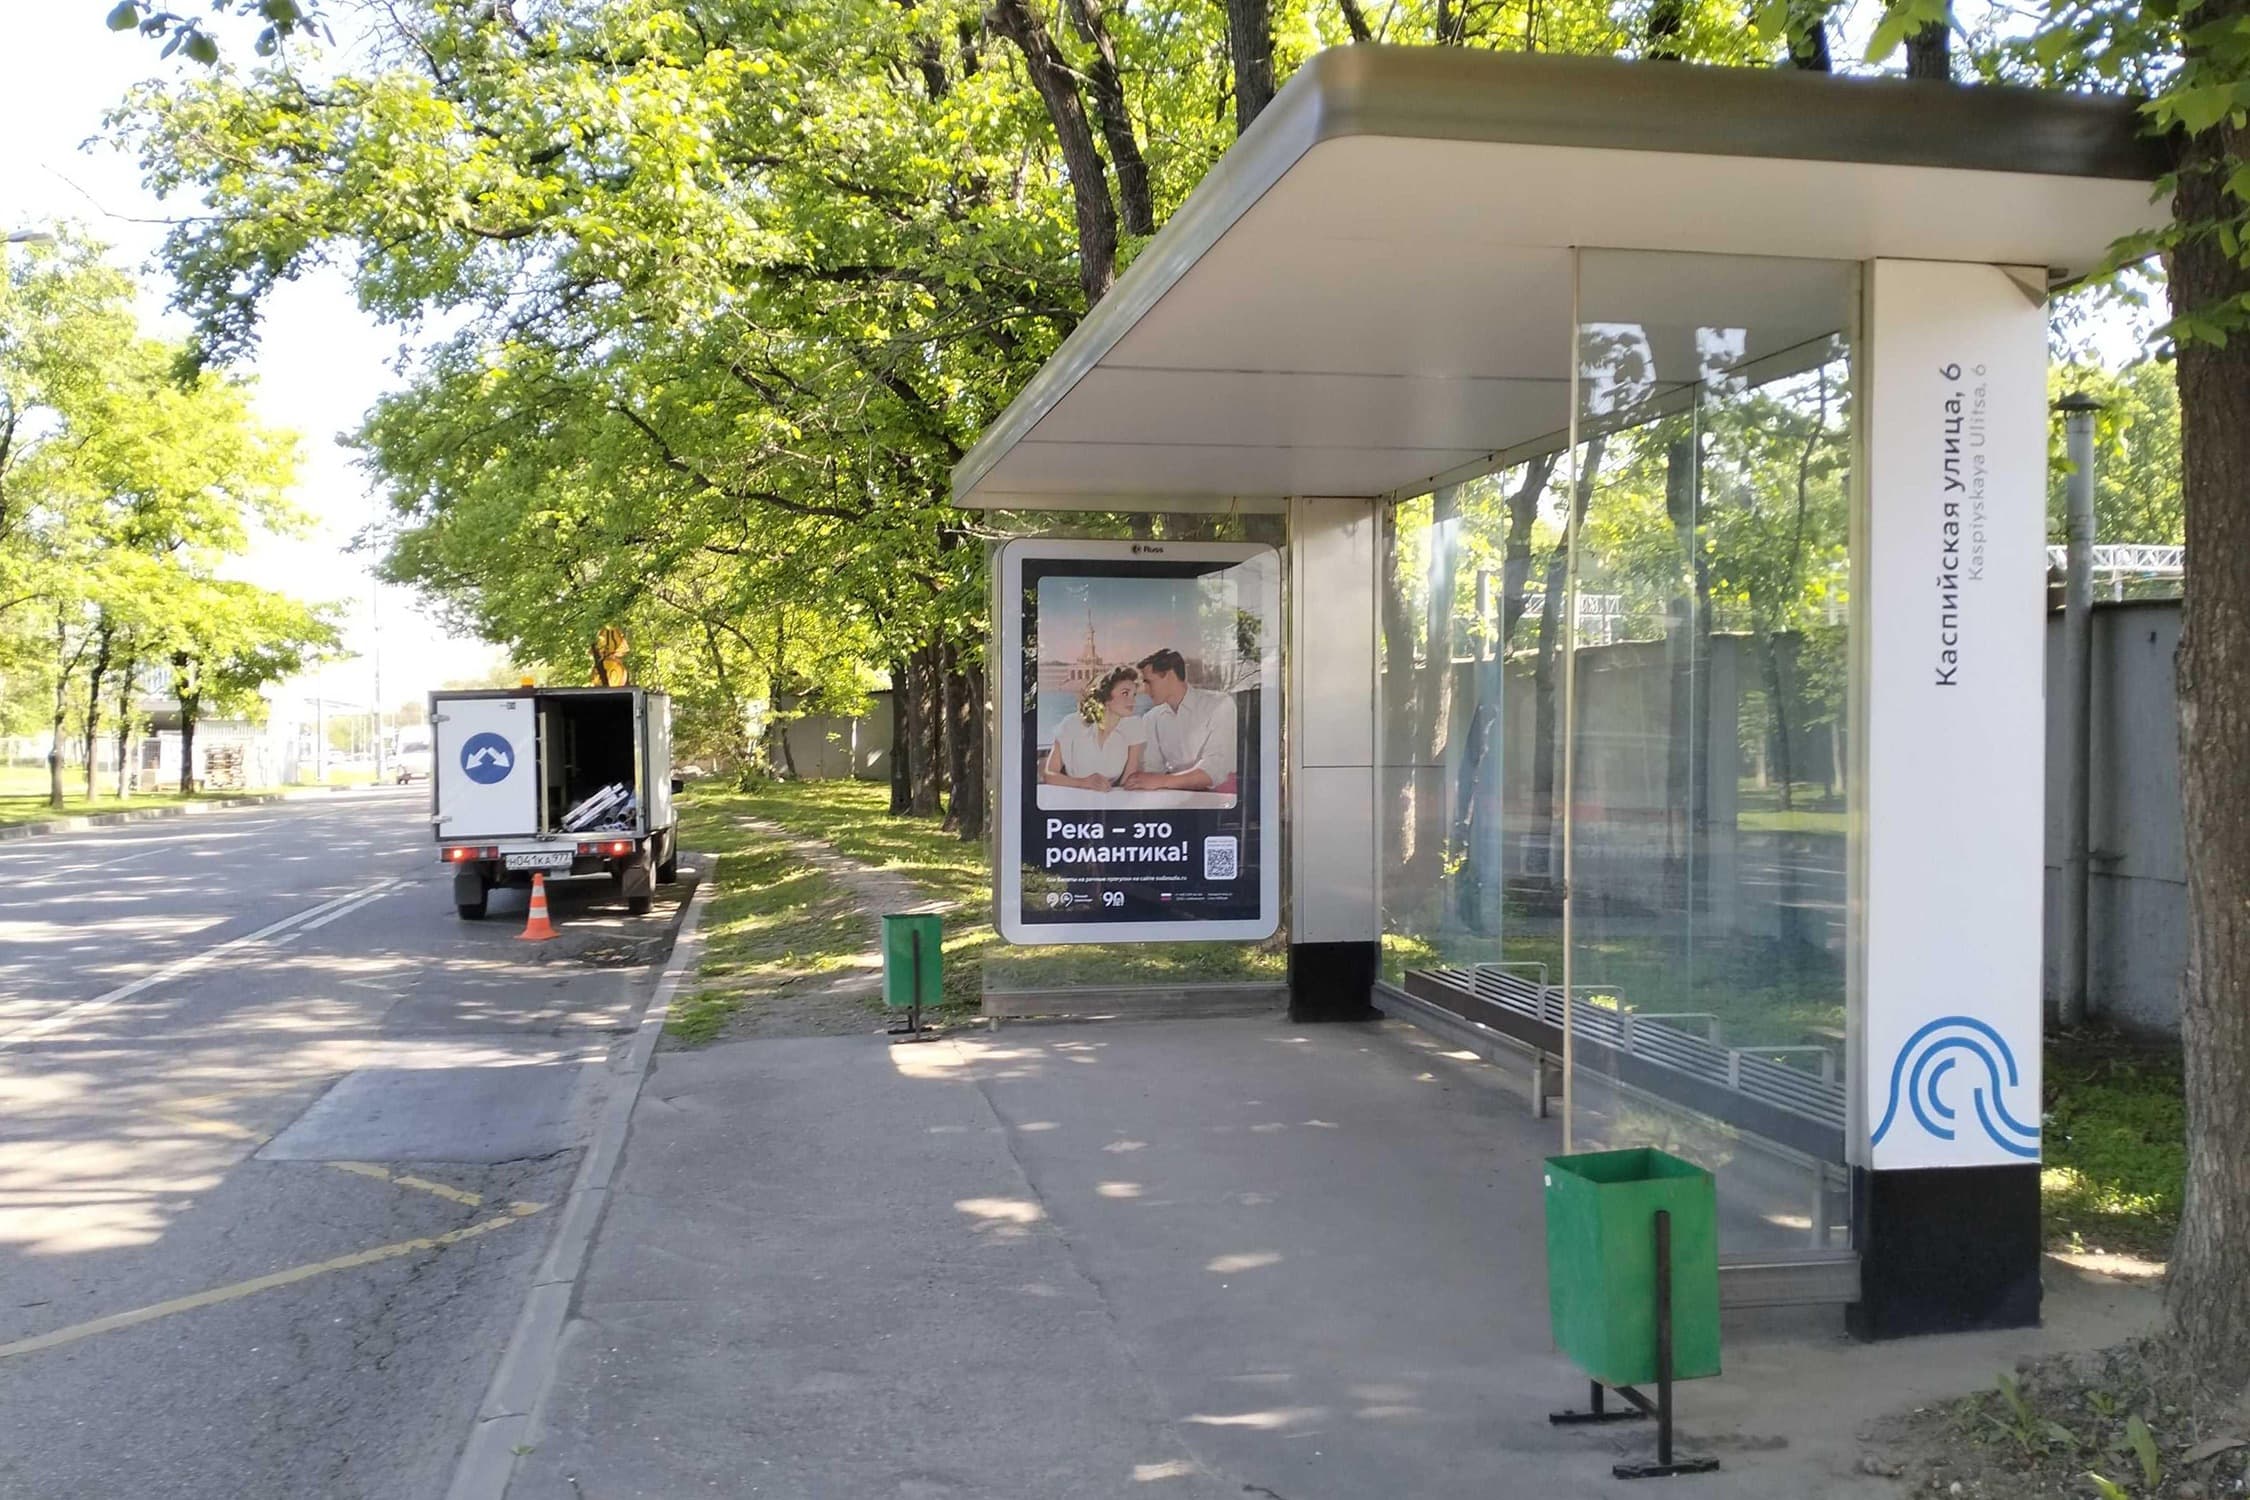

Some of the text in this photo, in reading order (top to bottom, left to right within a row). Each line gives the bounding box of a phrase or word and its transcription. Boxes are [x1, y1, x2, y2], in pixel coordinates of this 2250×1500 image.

[1936, 362, 1966, 686] Каспийская улица, 6
[1968, 364, 1989, 581] Kaspiyskaya Ulitsa, 6
[1045, 841, 1189, 869] романтика!
[1046, 818, 1104, 840] Река
[1133, 822, 1173, 840] это
